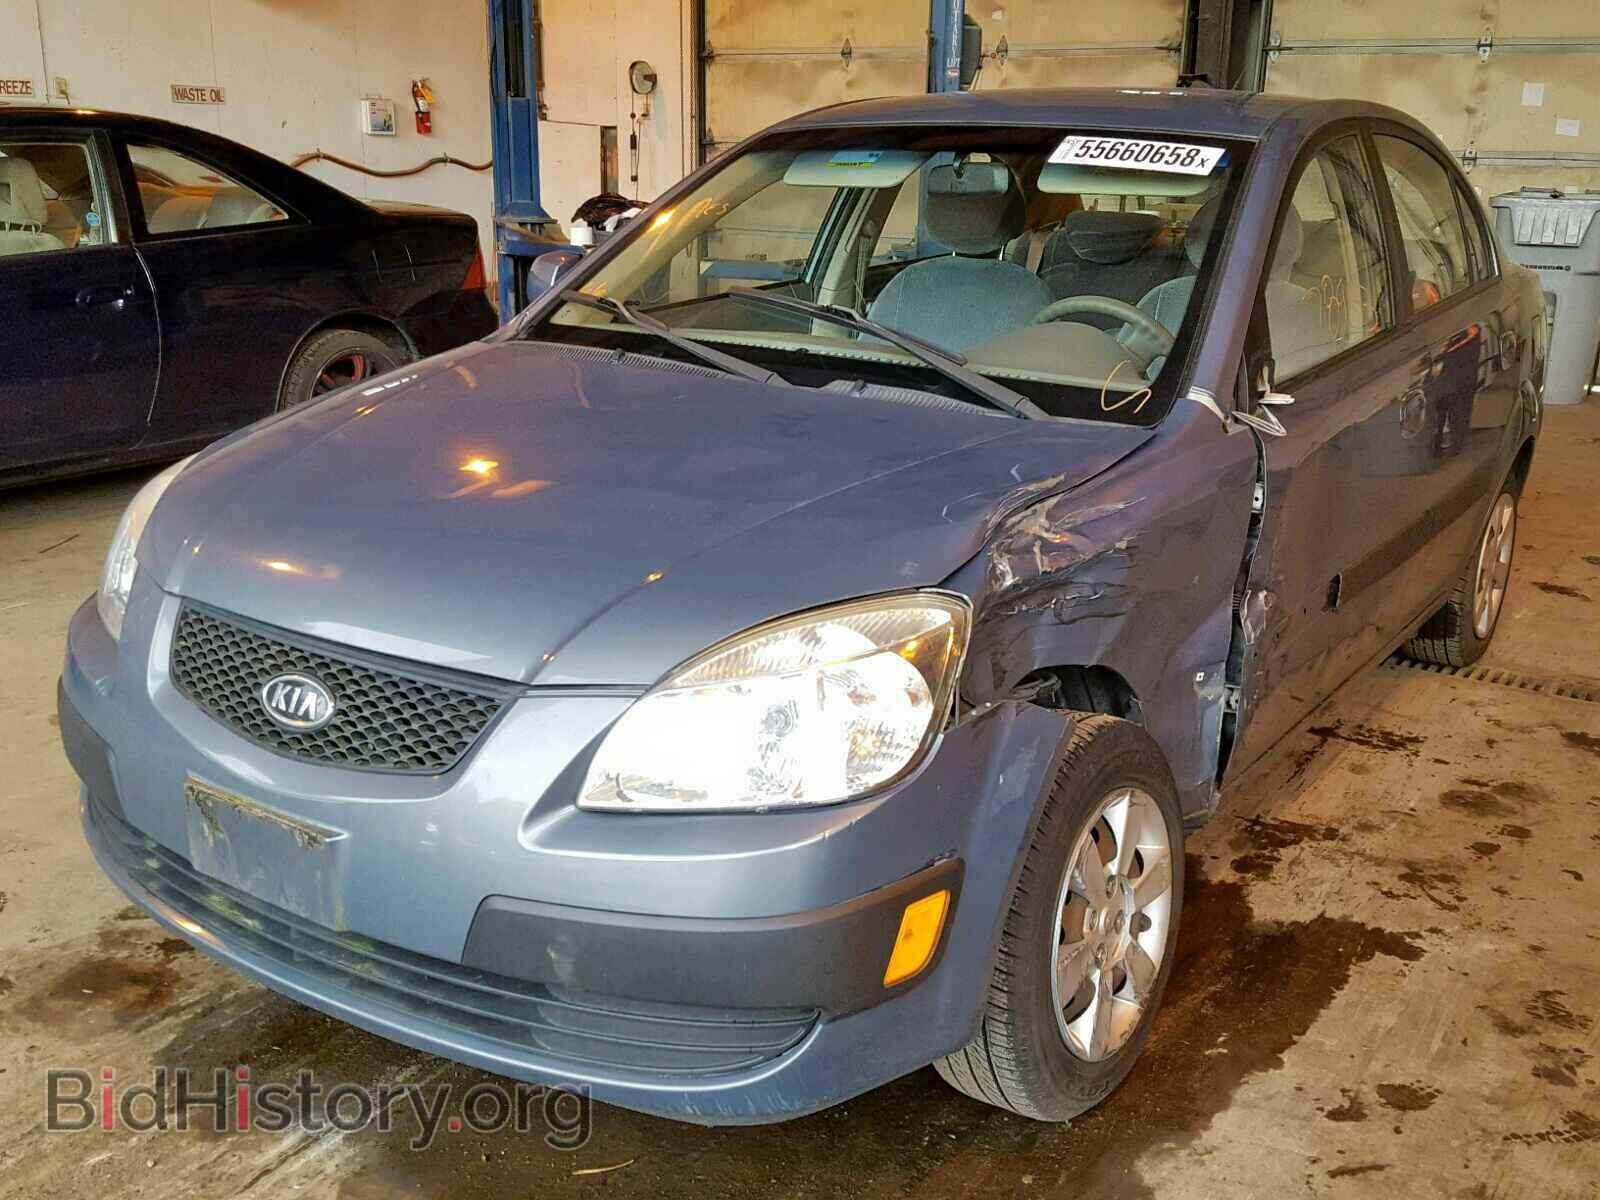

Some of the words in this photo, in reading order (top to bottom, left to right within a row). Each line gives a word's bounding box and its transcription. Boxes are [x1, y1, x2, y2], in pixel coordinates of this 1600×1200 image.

[0, 80, 33, 95] REEZE
[174, 87, 207, 102] WASTE
[209, 88, 225, 103] OIL
[271, 682, 317, 719] KIA
